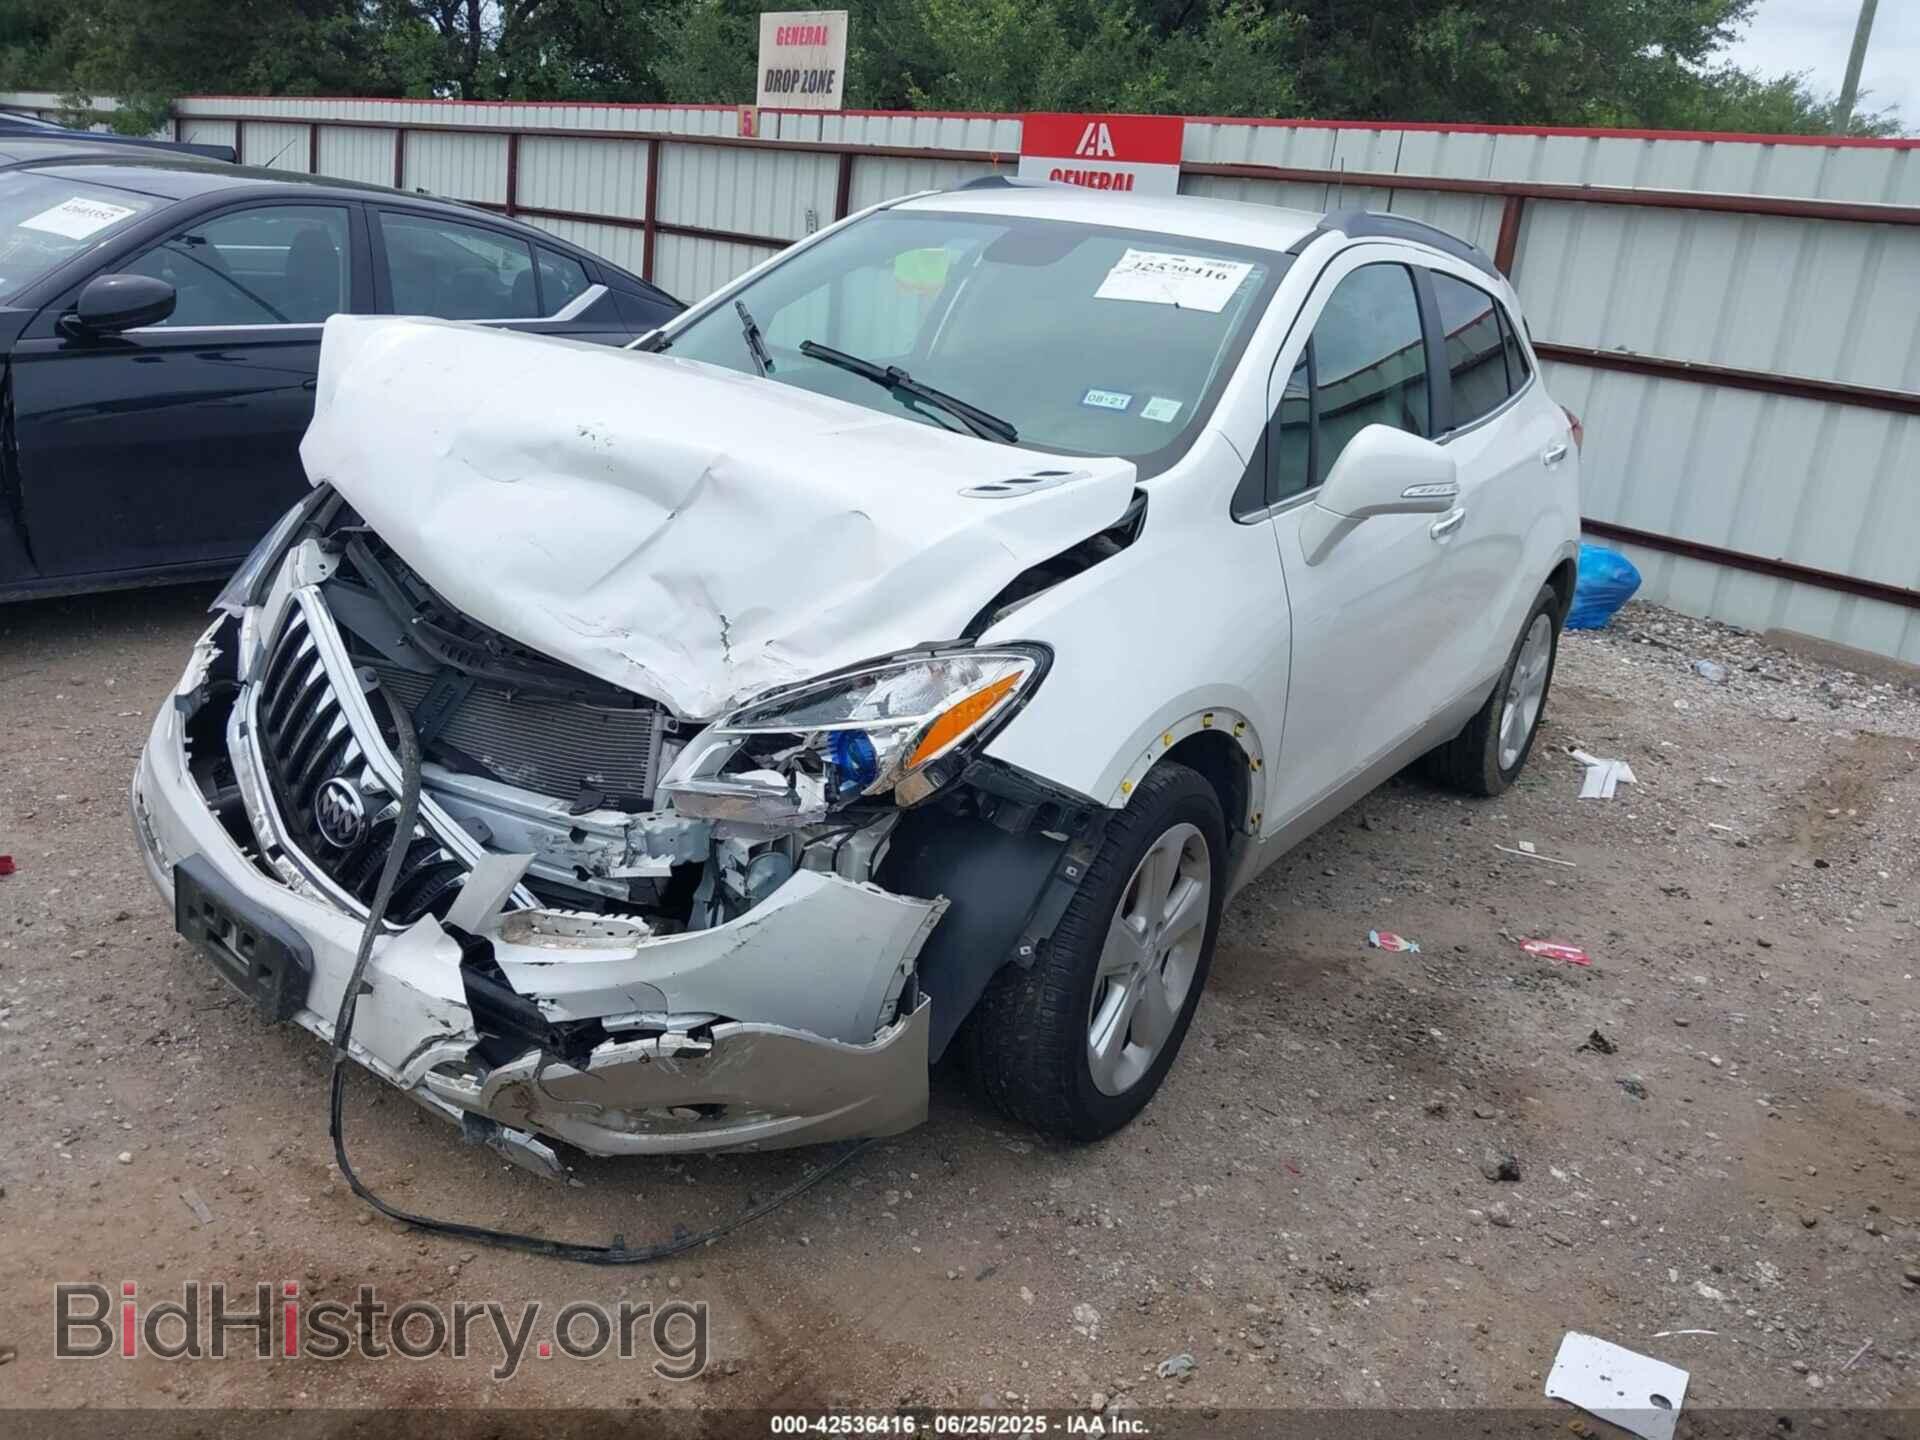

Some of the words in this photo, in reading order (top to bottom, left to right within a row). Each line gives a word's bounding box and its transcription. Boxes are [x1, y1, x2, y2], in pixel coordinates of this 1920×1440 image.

[776, 25, 828, 46] GENERAL
[764, 69, 799, 93] DROP
[800, 69, 836, 94] ZONE
